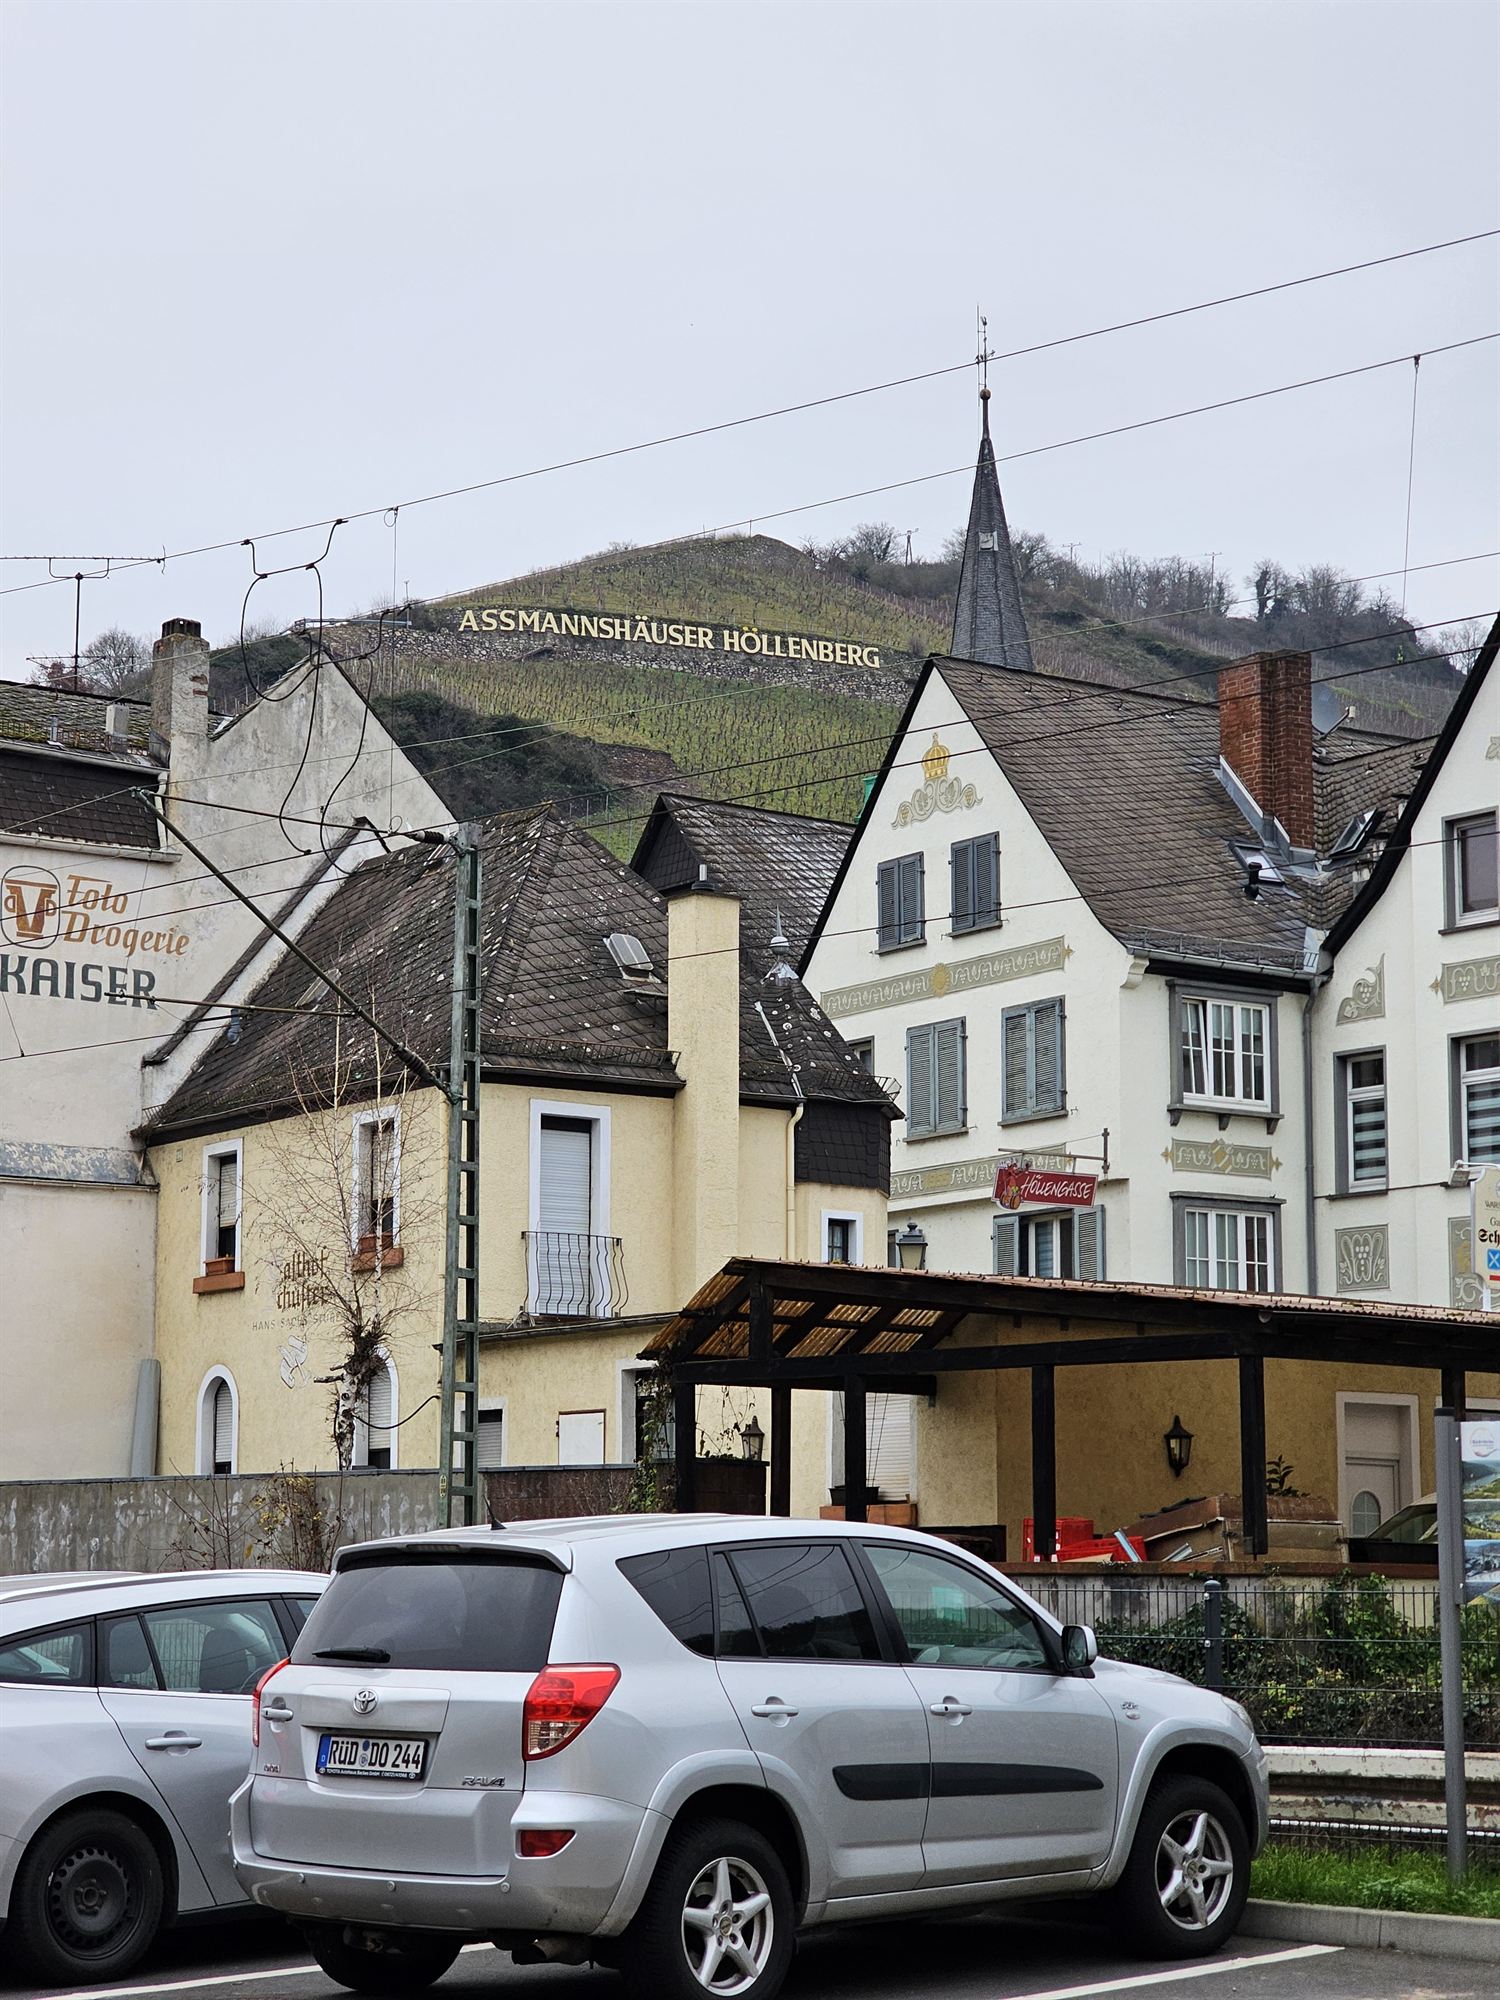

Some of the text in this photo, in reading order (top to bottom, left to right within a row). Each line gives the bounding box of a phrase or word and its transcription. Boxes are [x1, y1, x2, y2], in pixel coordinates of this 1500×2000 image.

[458, 609, 880, 668] ASSMANNSHÄUSER HÖLLENBERG
[66, 874, 128, 914] Foto
[62, 910, 190, 957] Drogerie
[0, 954, 158, 1010] KAISER
[1020, 1174, 1093, 1199] HÖLLENGASSE
[251, 1319, 276, 1332] HANS
[329, 1740, 421, 1770] RÜD DO 244
[461, 1775, 506, 1788] RAV4
